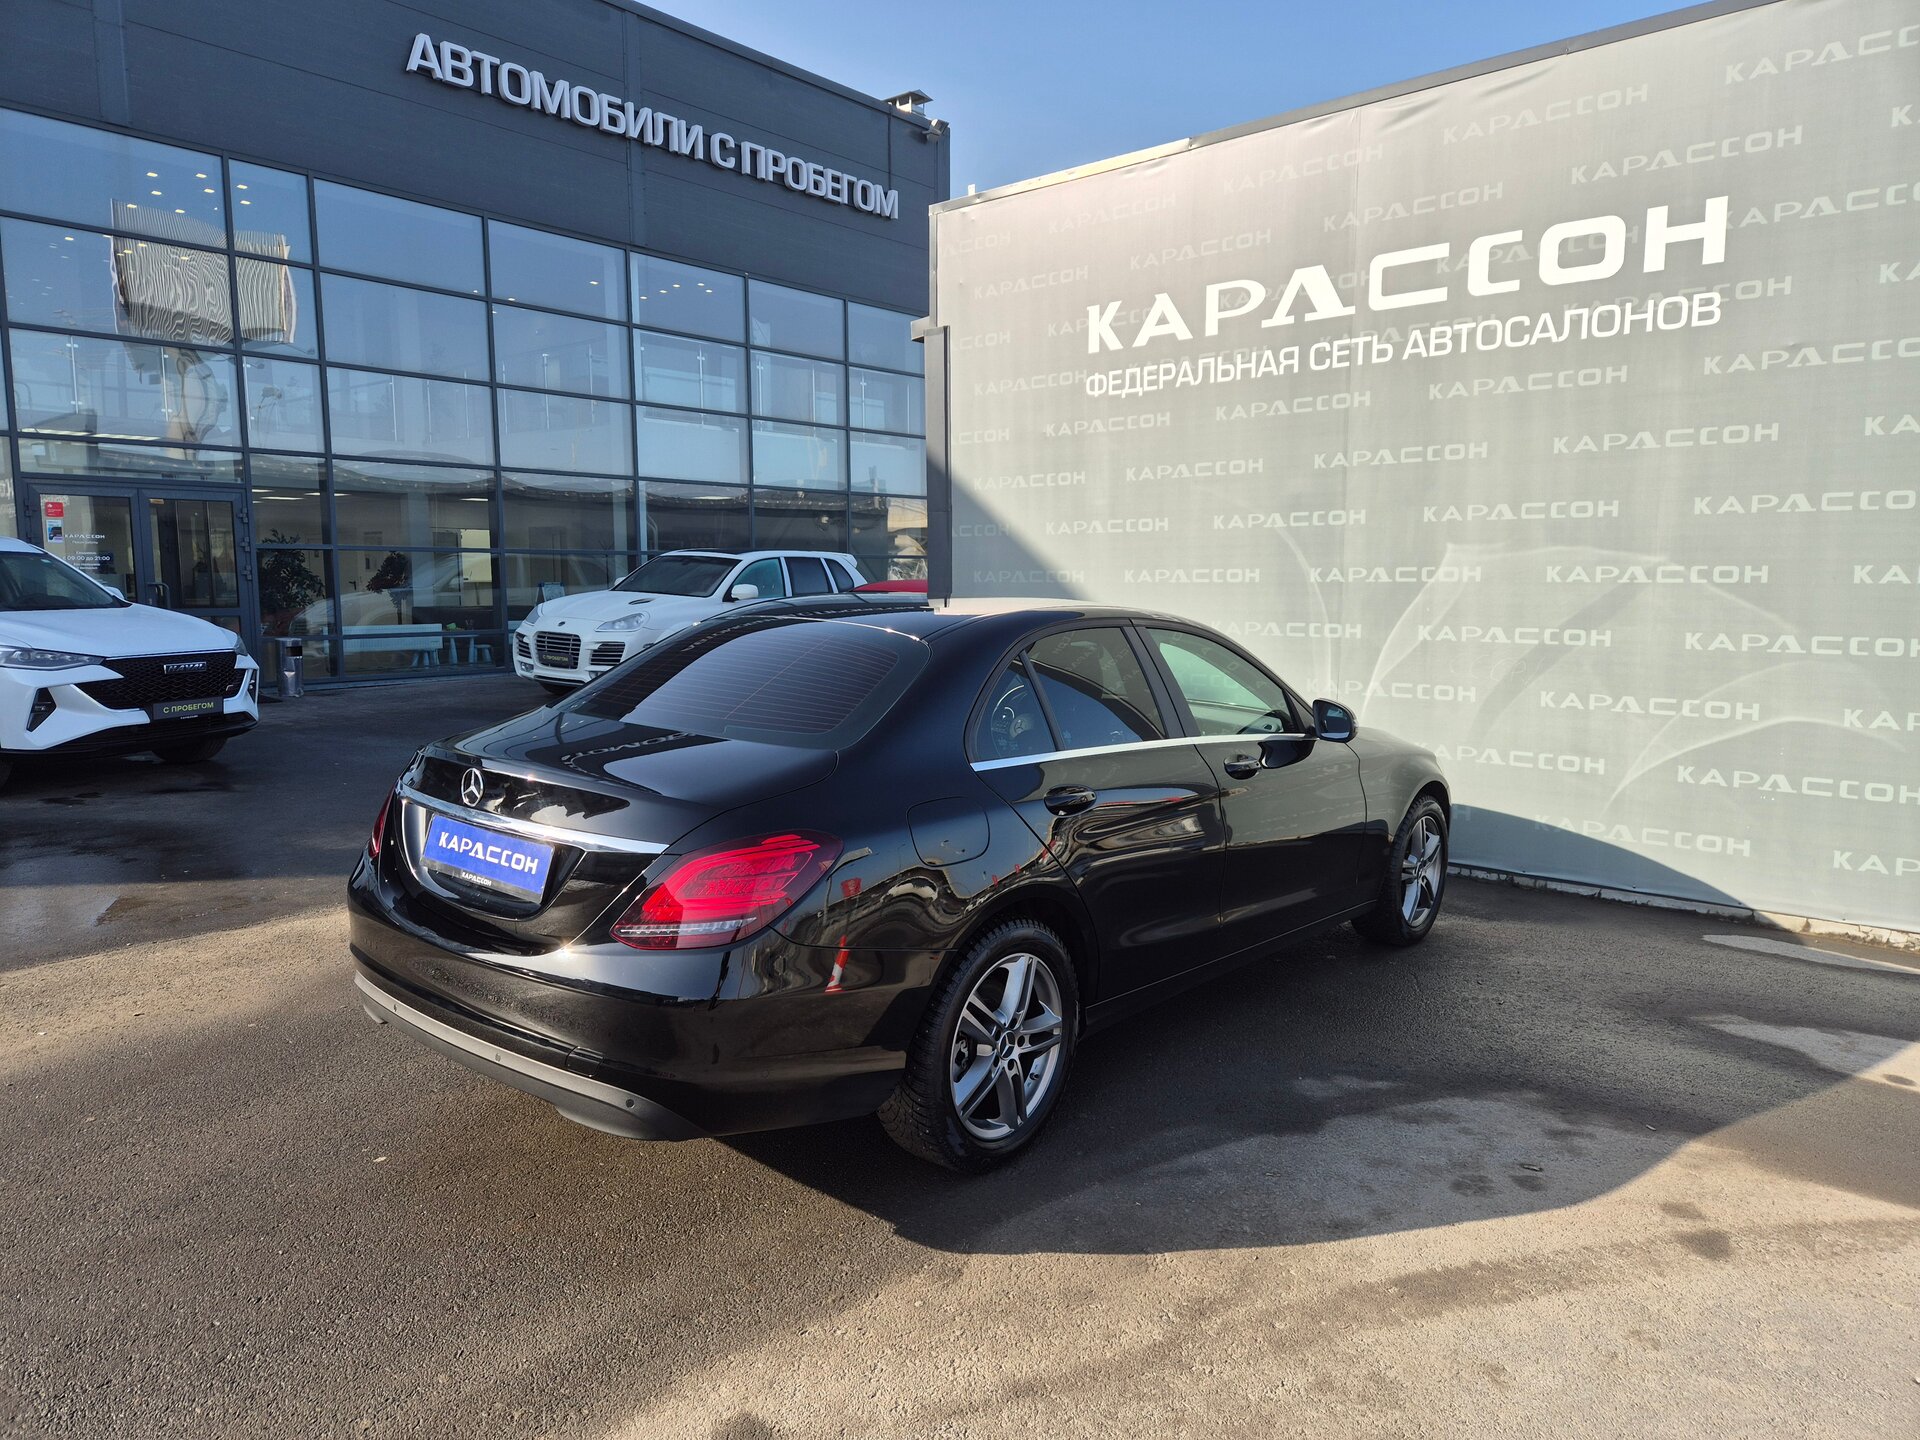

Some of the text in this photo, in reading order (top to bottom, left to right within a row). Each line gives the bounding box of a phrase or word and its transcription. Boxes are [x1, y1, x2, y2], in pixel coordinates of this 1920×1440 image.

[406, 33, 899, 220] АВТОМОБИЛИ С ПРОБЕГОМ
[1087, 195, 1728, 353] КАРАССОН
[1086, 291, 1722, 398] ФЕДЕРАЛЬНАЯ СЕТЬ АВТОСАЛОНОВ
[171, 702, 215, 713] ПРОБЕГОМ
[438, 831, 538, 875] КАРАССОН
